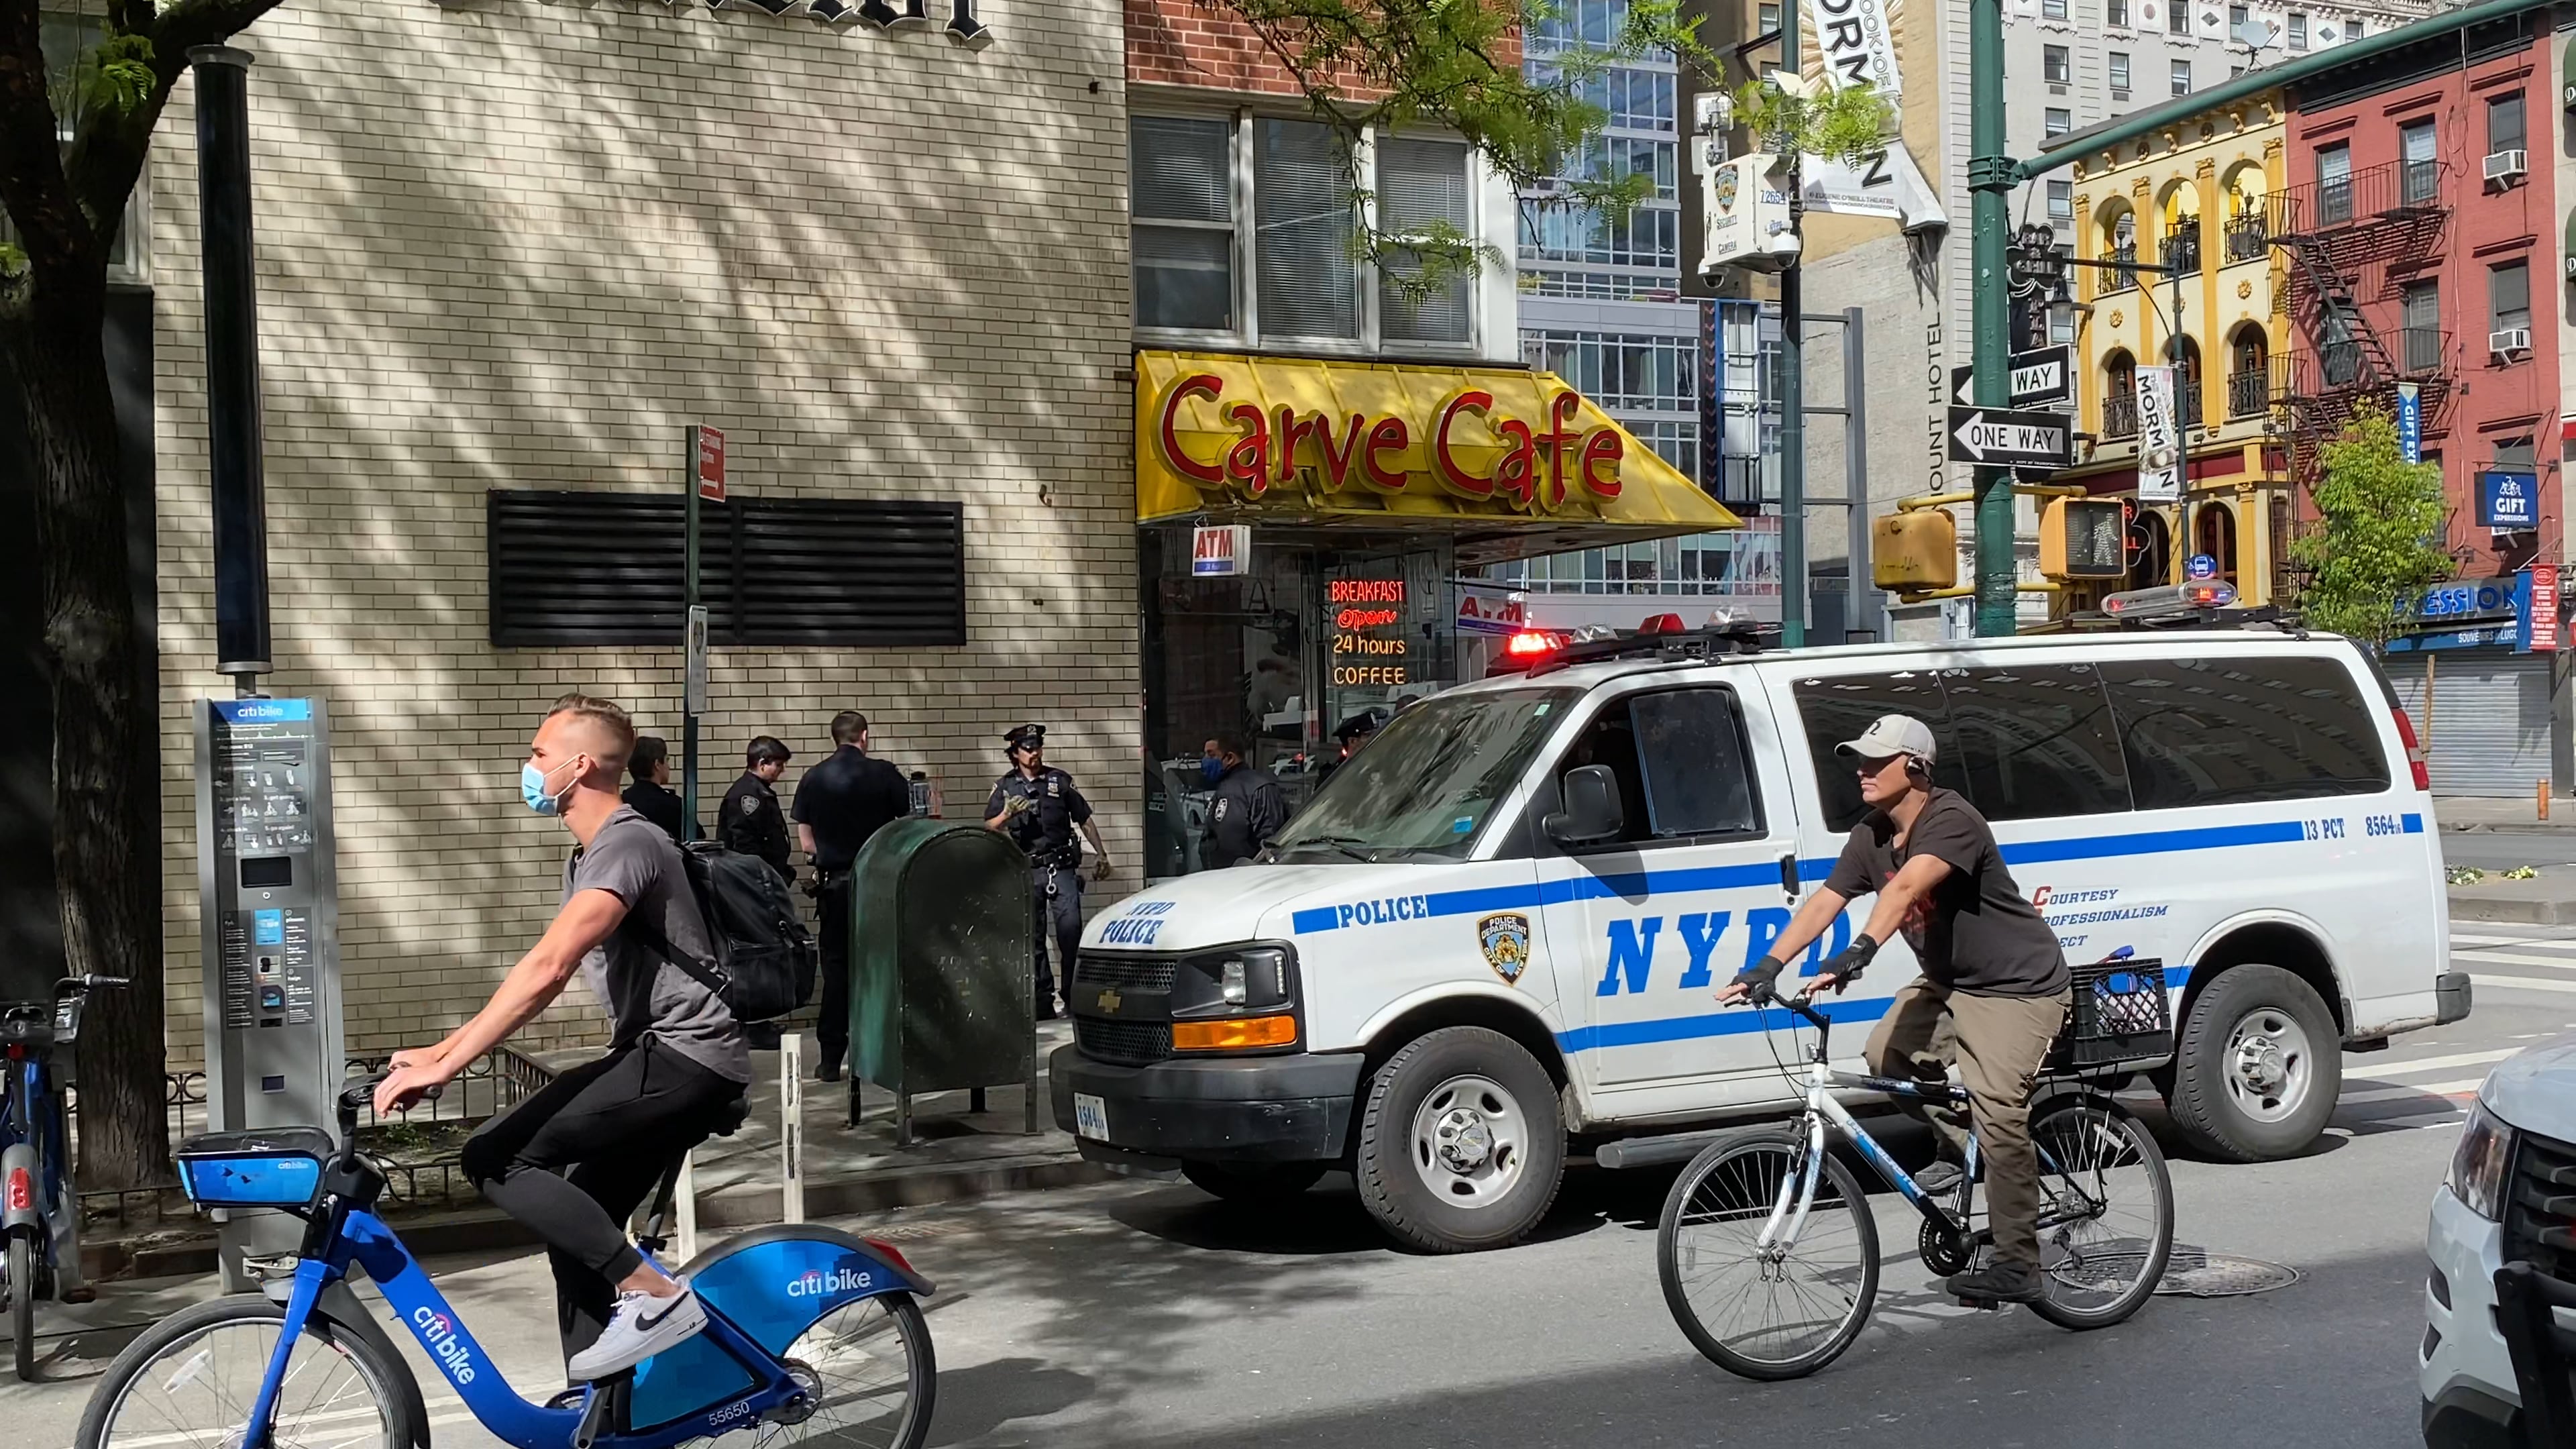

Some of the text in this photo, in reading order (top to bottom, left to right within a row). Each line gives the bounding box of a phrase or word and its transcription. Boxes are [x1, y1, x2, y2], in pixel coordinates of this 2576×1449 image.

[1873, 55, 1892, 86] OF
[1927, 311, 1941, 404] HOTEL
[2016, 366, 2051, 392] WAY
[2404, 405, 2415, 437] GIFT
[1157, 372, 1624, 506] Carve Cafe
[1971, 425, 2055, 449] ONE WAY
[2496, 497, 2526, 513] GIFT
[1195, 529, 1233, 558] ATM
[1332, 581, 1403, 602] BREAKFAST
[1333, 634, 1406, 655] 24 hours
[1334, 667, 1405, 685] COFFEE
[237, 706, 284, 717] citi bike
[2304, 820, 2318, 840] 13
[2321, 818, 2345, 839] PCT
[2033, 885, 2118, 907] COURTESY
[1338, 895, 1426, 928] POLICE
[1489, 916, 1517, 926] POLICE
[2035, 906, 2168, 927] ROFESSIONALISM
[1099, 919, 1165, 945] POLICE
[1481, 924, 1527, 940] DEPARTMENT
[1484, 947, 1497, 963] CITY
[1595, 908, 1851, 997] NYPD
[787, 1269, 871, 1297] citi bike
[414, 1306, 475, 1385] citi bike
[708, 1401, 750, 1426] 55650
